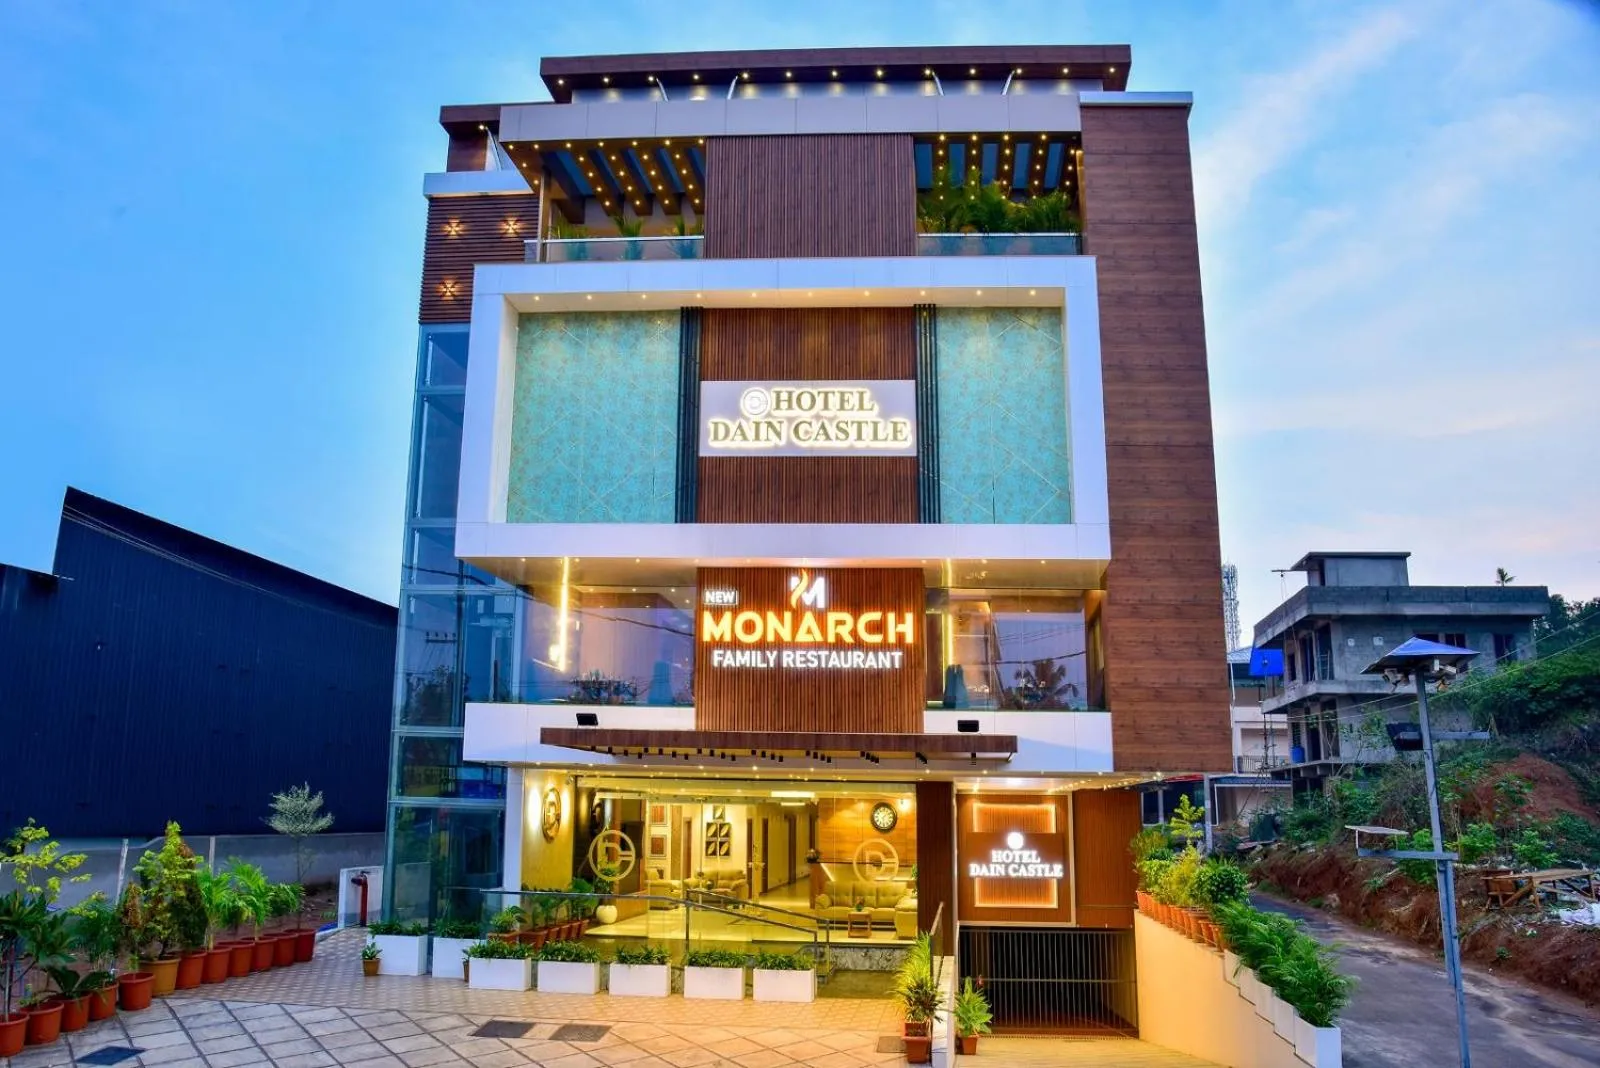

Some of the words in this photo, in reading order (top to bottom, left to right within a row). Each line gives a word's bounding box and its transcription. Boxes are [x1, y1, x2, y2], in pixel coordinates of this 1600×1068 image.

[772, 390, 875, 411] HOTEL
[711, 421, 785, 442] DAIN
[793, 420, 908, 442] CASTLE
[705, 590, 737, 604] NEW
[702, 611, 914, 643] MONARCH
[713, 651, 777, 668] FAMILY
[783, 651, 902, 669] RESTAURANT
[991, 850, 1041, 863] HOTEL
[969, 863, 1006, 877] DAIN
[1008, 864, 1063, 877] CASTLE
